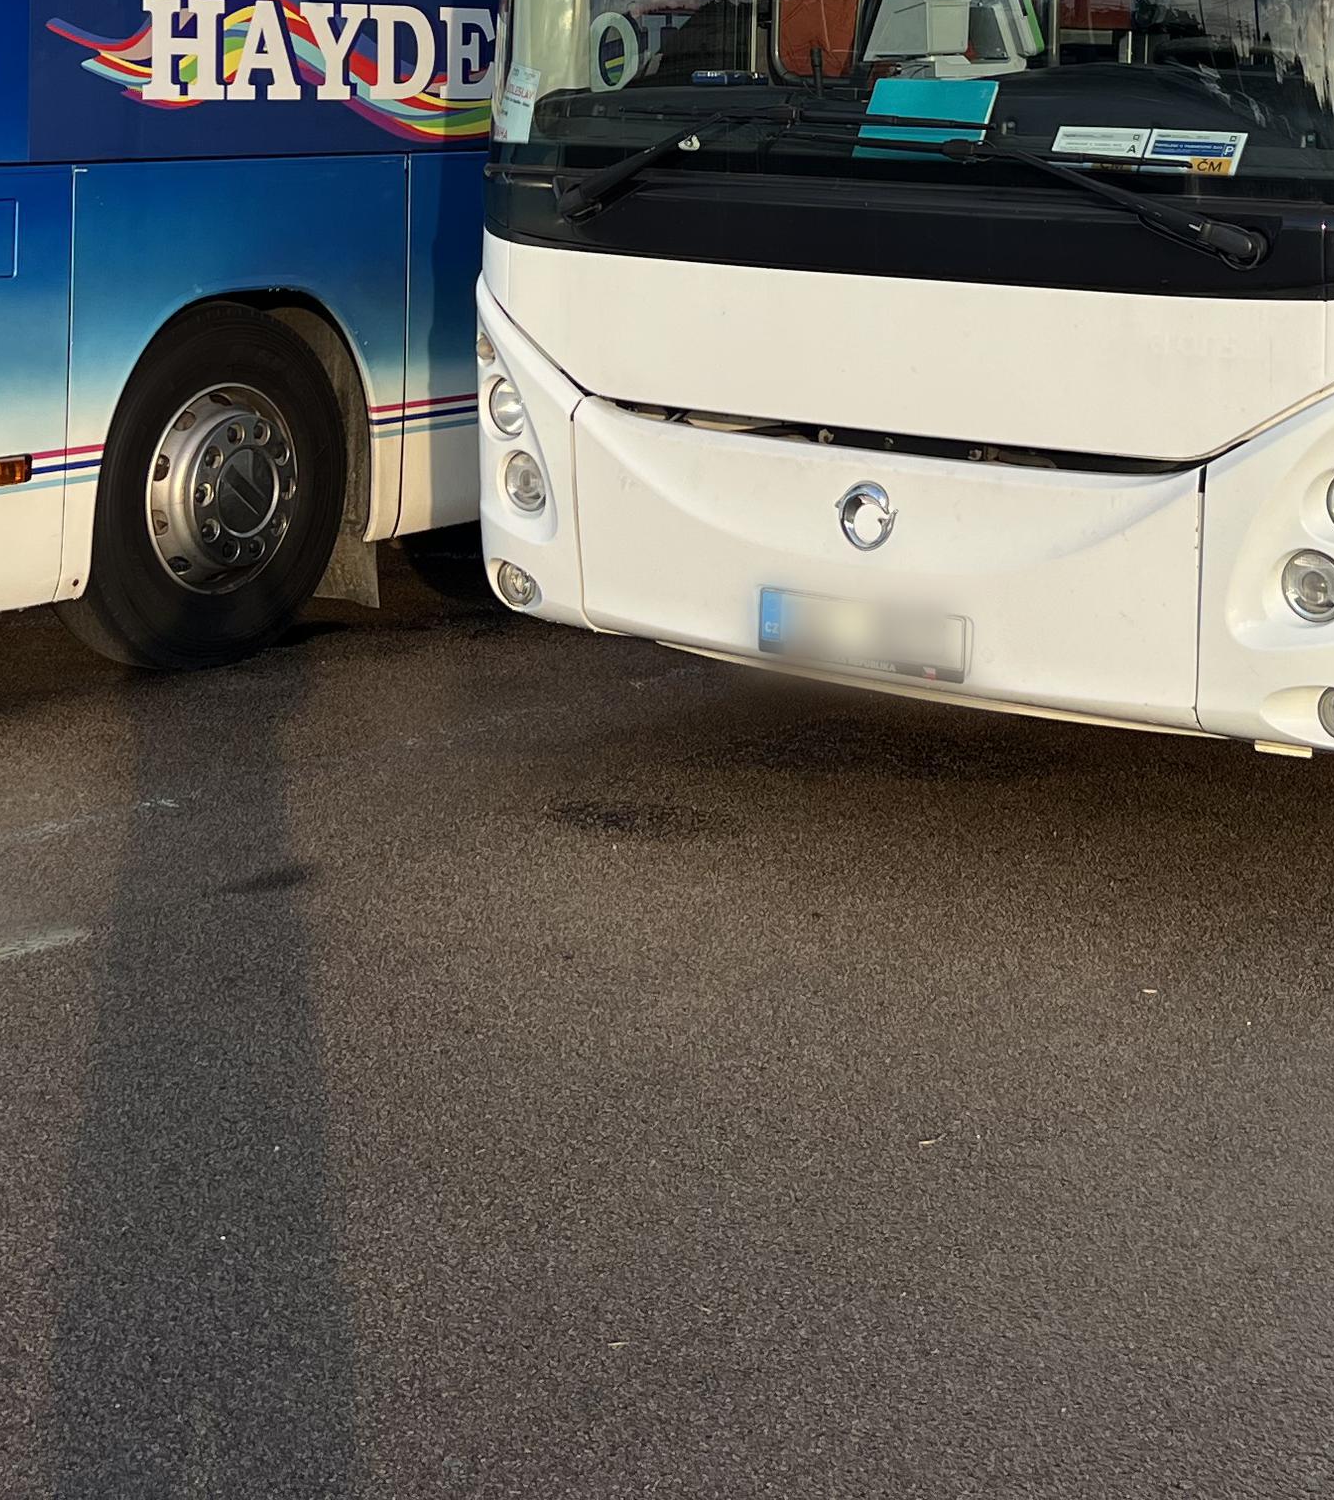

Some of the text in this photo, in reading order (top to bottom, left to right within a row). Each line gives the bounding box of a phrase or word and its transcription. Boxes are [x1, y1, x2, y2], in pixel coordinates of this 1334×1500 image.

[1126, 144, 1136, 154] A
[1224, 146, 1235, 156] P
[1196, 158, 1223, 173] ČM
[764, 621, 780, 635] CZ
